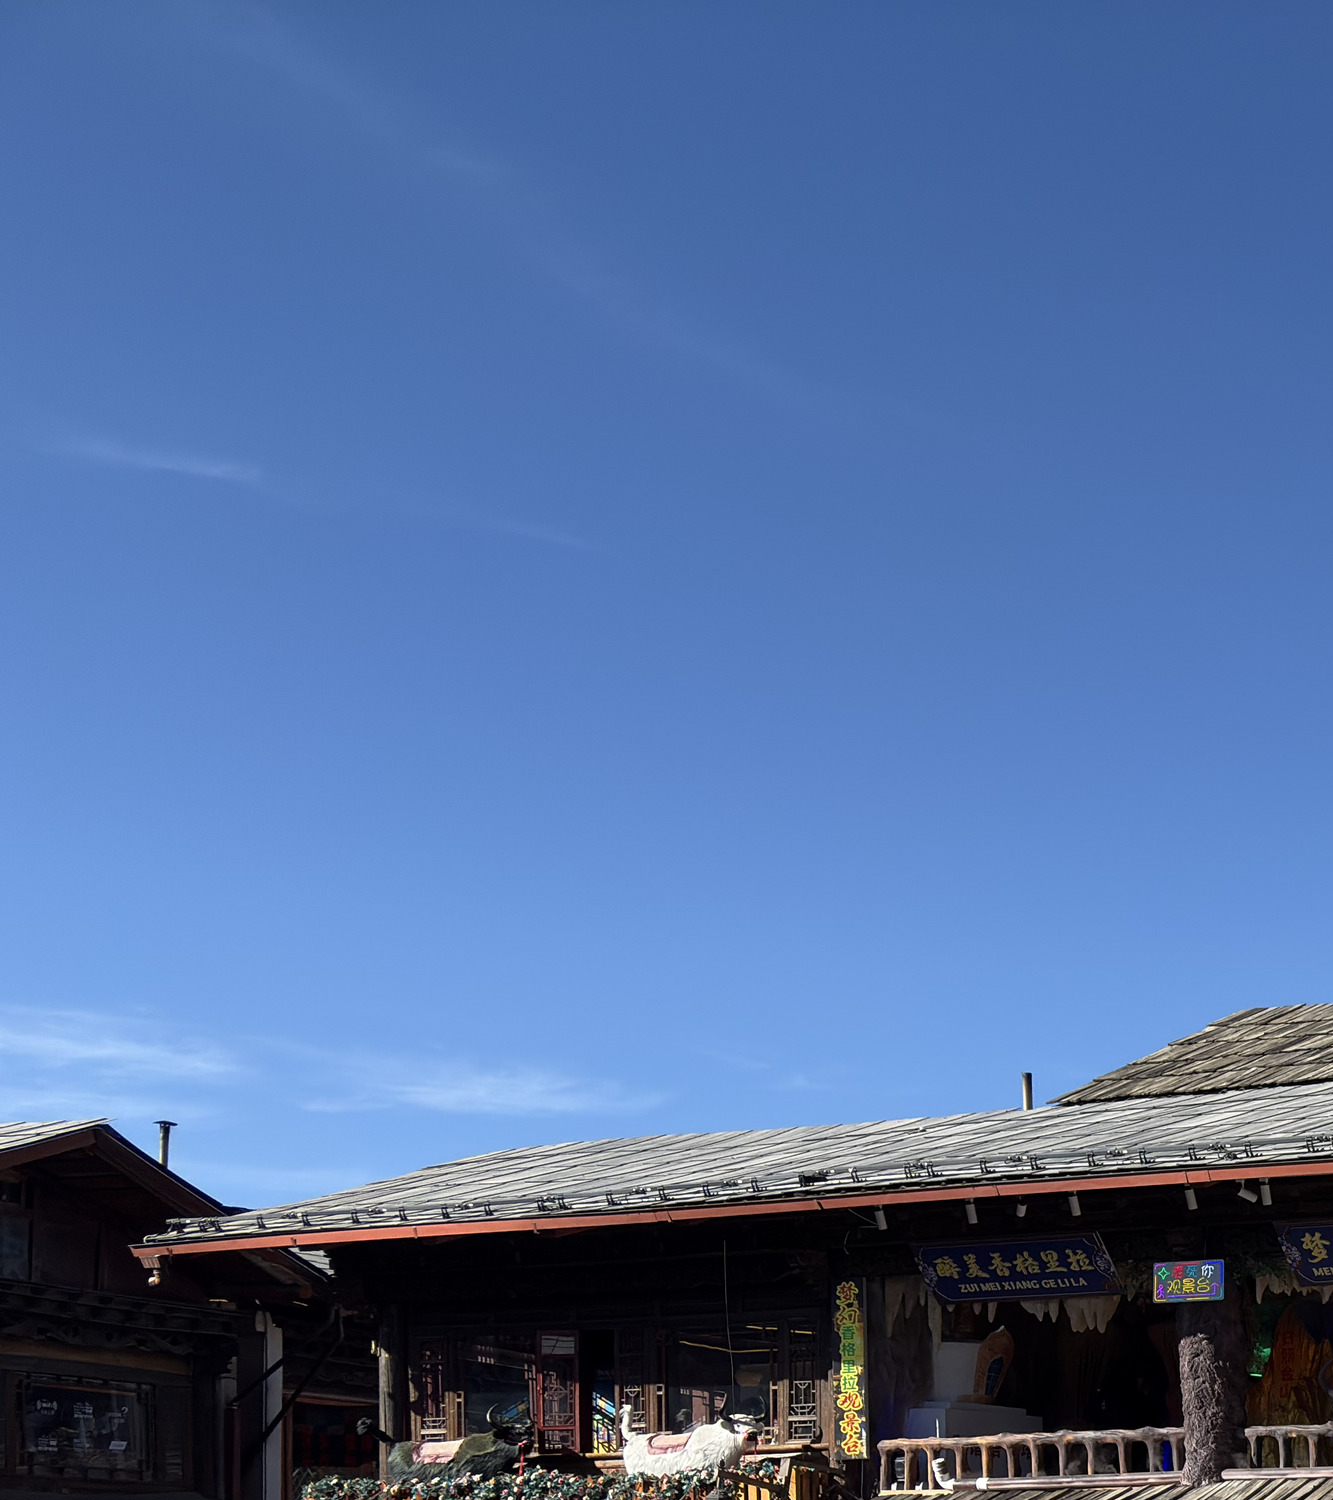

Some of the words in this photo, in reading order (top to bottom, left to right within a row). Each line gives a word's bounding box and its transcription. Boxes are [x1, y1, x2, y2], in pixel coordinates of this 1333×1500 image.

[932, 1249, 1094, 1279] 醉美香格里拉
[958, 1282, 981, 1293] ZUI
[984, 1281, 1001, 1291] MEI
[1004, 1279, 1040, 1291] XIANG
[1167, 1277, 1210, 1294] 观景台
[836, 1281, 863, 1456] 梦幻香格里拉观景台
